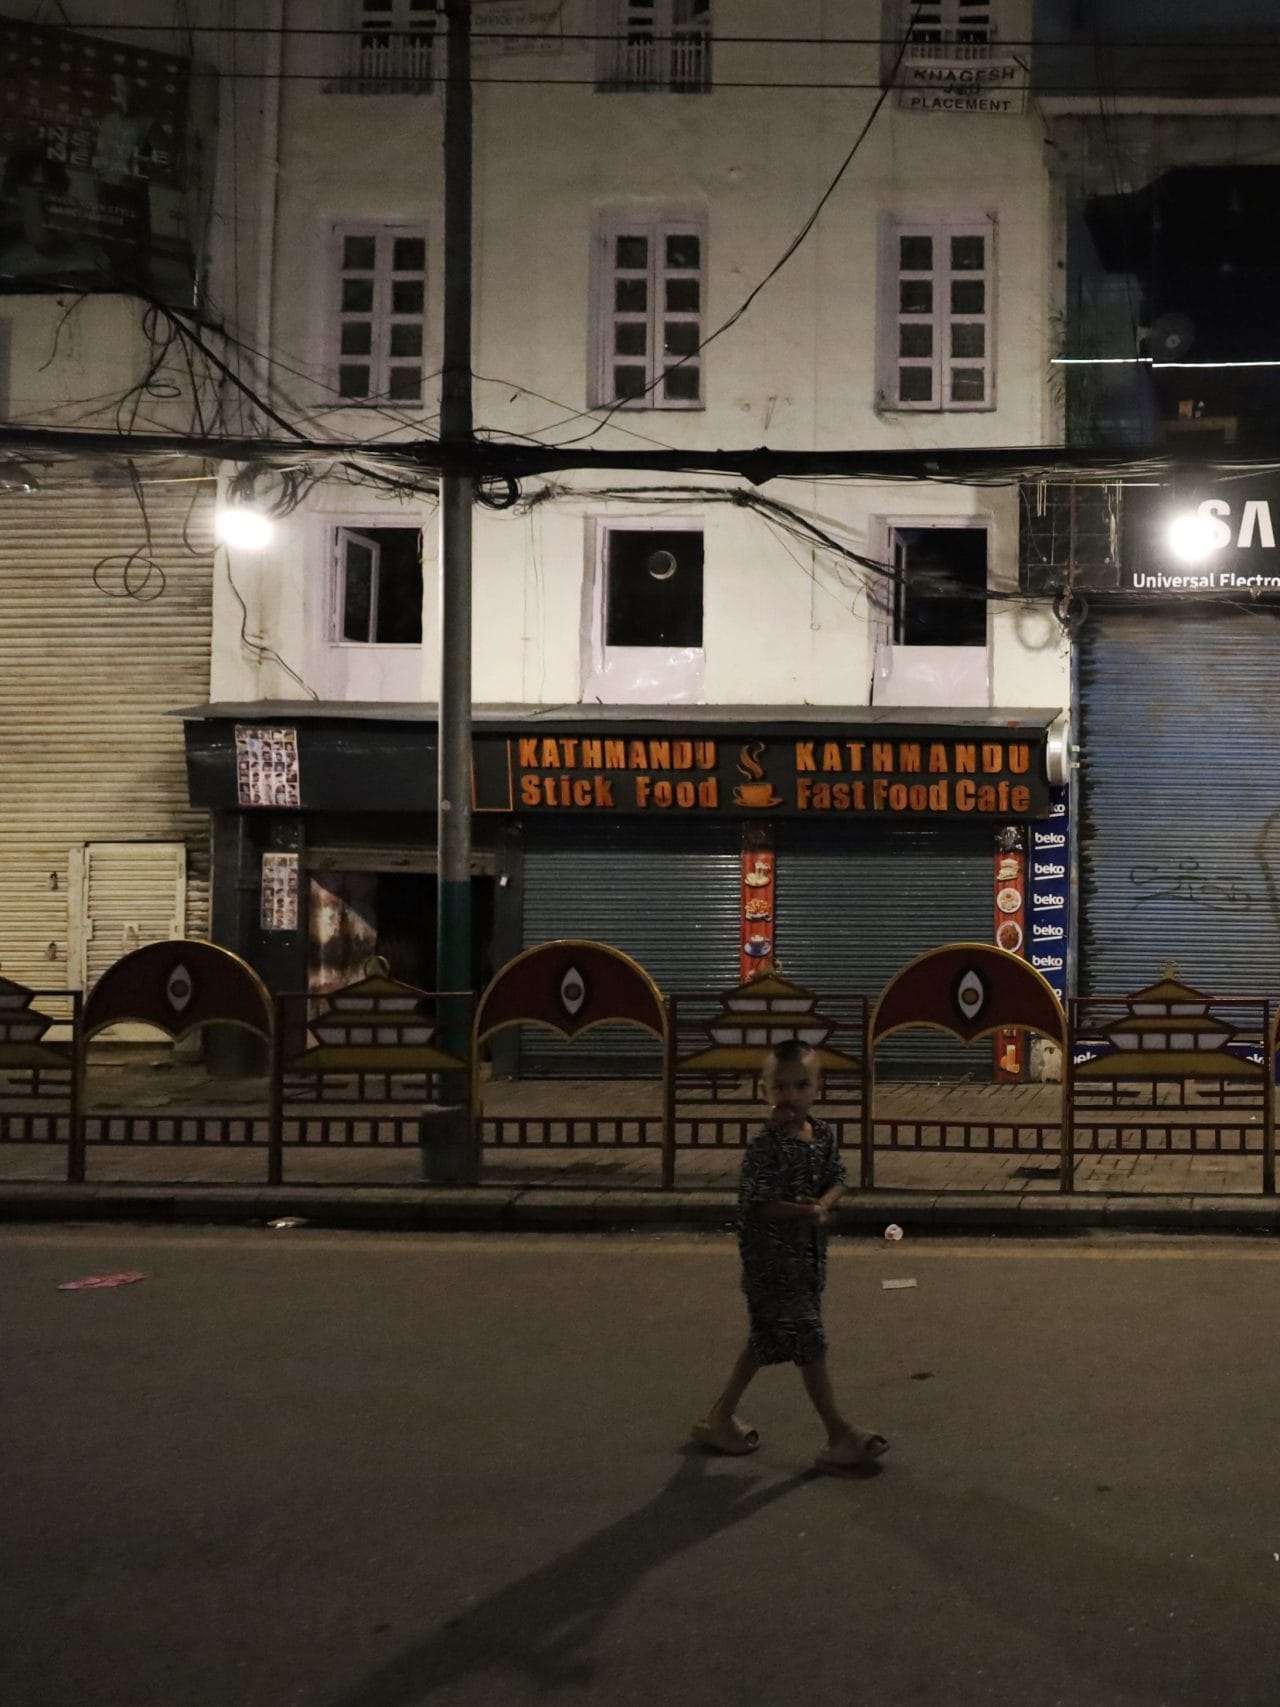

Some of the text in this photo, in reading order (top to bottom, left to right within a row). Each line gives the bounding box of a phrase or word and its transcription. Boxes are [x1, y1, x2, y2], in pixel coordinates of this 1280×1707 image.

[911, 96, 1011, 112] PLACEMENT
[1133, 573, 1215, 588] Universal
[518, 737, 717, 771] KATHMANDU
[794, 740, 1032, 775] KATHMANDU
[520, 773, 720, 809] Stick Food
[796, 777, 1031, 814] Fast Food Cafe
[1034, 832, 1065, 844] beko
[1034, 862, 1065, 875] beko
[1033, 893, 1064, 905] beko
[1032, 924, 1063, 936] beko
[1032, 954, 1063, 967] beko
